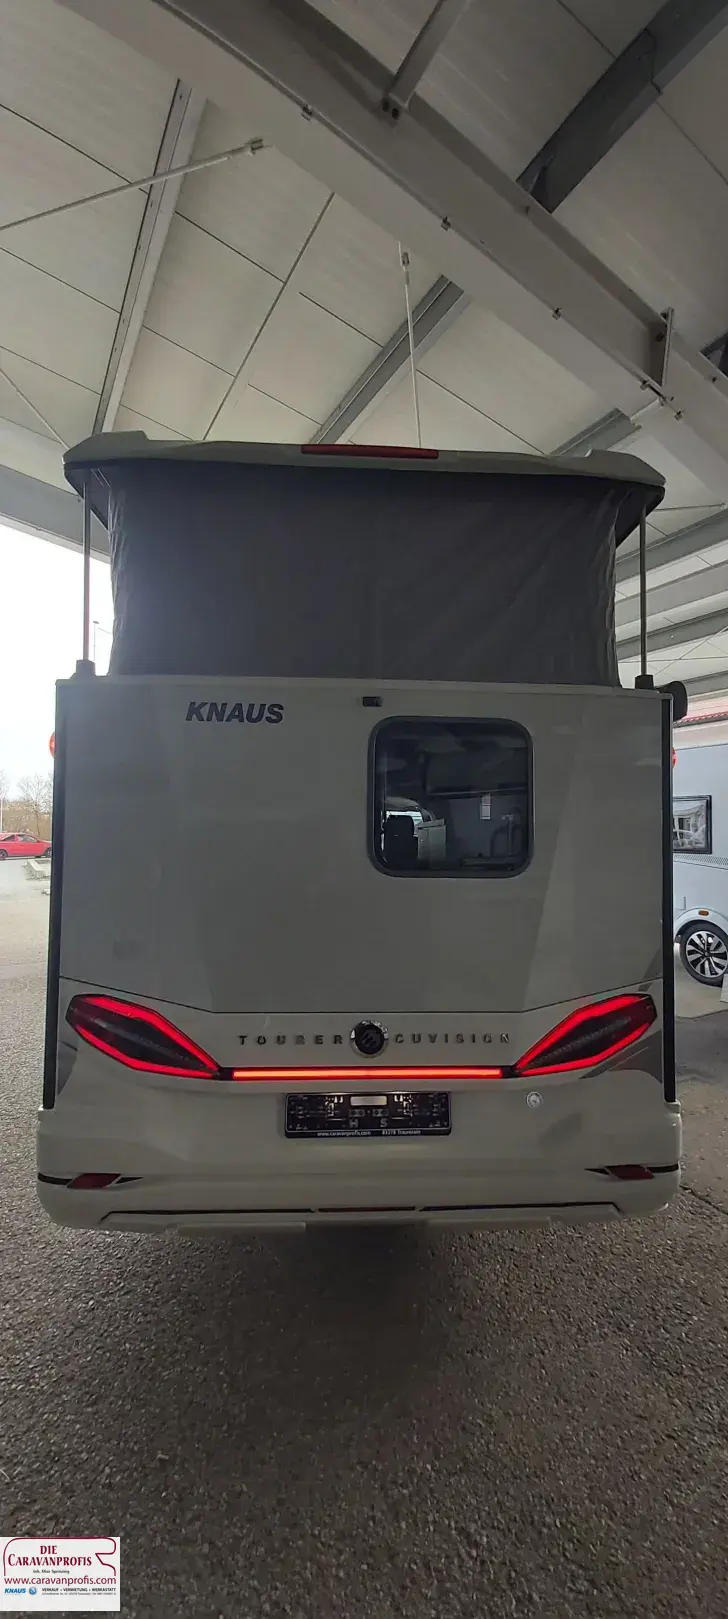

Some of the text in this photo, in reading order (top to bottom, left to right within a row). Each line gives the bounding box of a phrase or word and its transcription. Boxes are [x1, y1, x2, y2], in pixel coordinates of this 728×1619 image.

[185, 701, 284, 724] KNAUS
[237, 1033, 511, 1046] TOURER CUVISION
